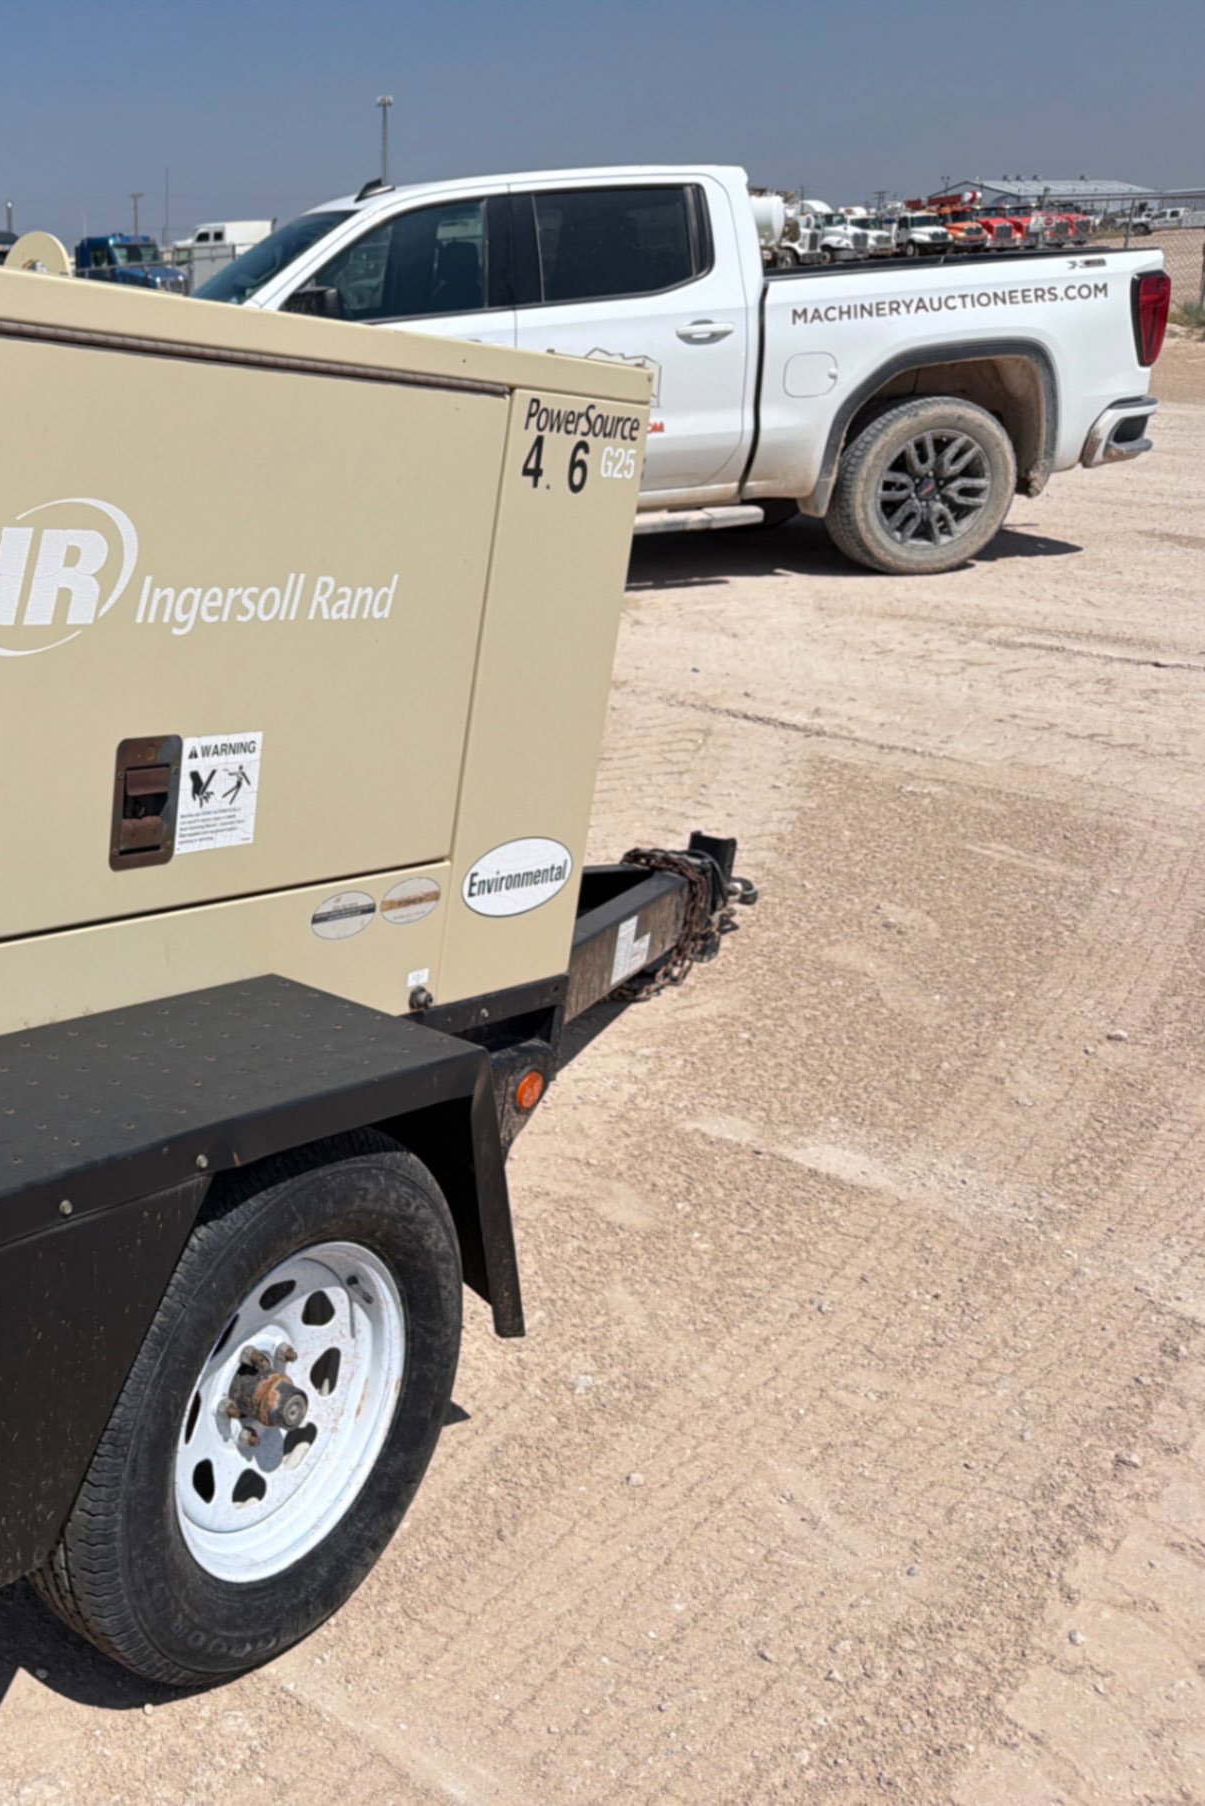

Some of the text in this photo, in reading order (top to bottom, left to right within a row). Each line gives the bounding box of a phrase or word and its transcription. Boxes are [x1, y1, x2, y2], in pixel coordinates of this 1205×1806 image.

[792, 282, 1109, 325] MACHINERYAUCTIONEERS.COM
[524, 398, 640, 441] PowerSource
[600, 445, 637, 479] G25
[135, 573, 398, 635] Ingersoll Rand
[200, 740, 257, 758] WARNING
[468, 860, 568, 897] Environmental
